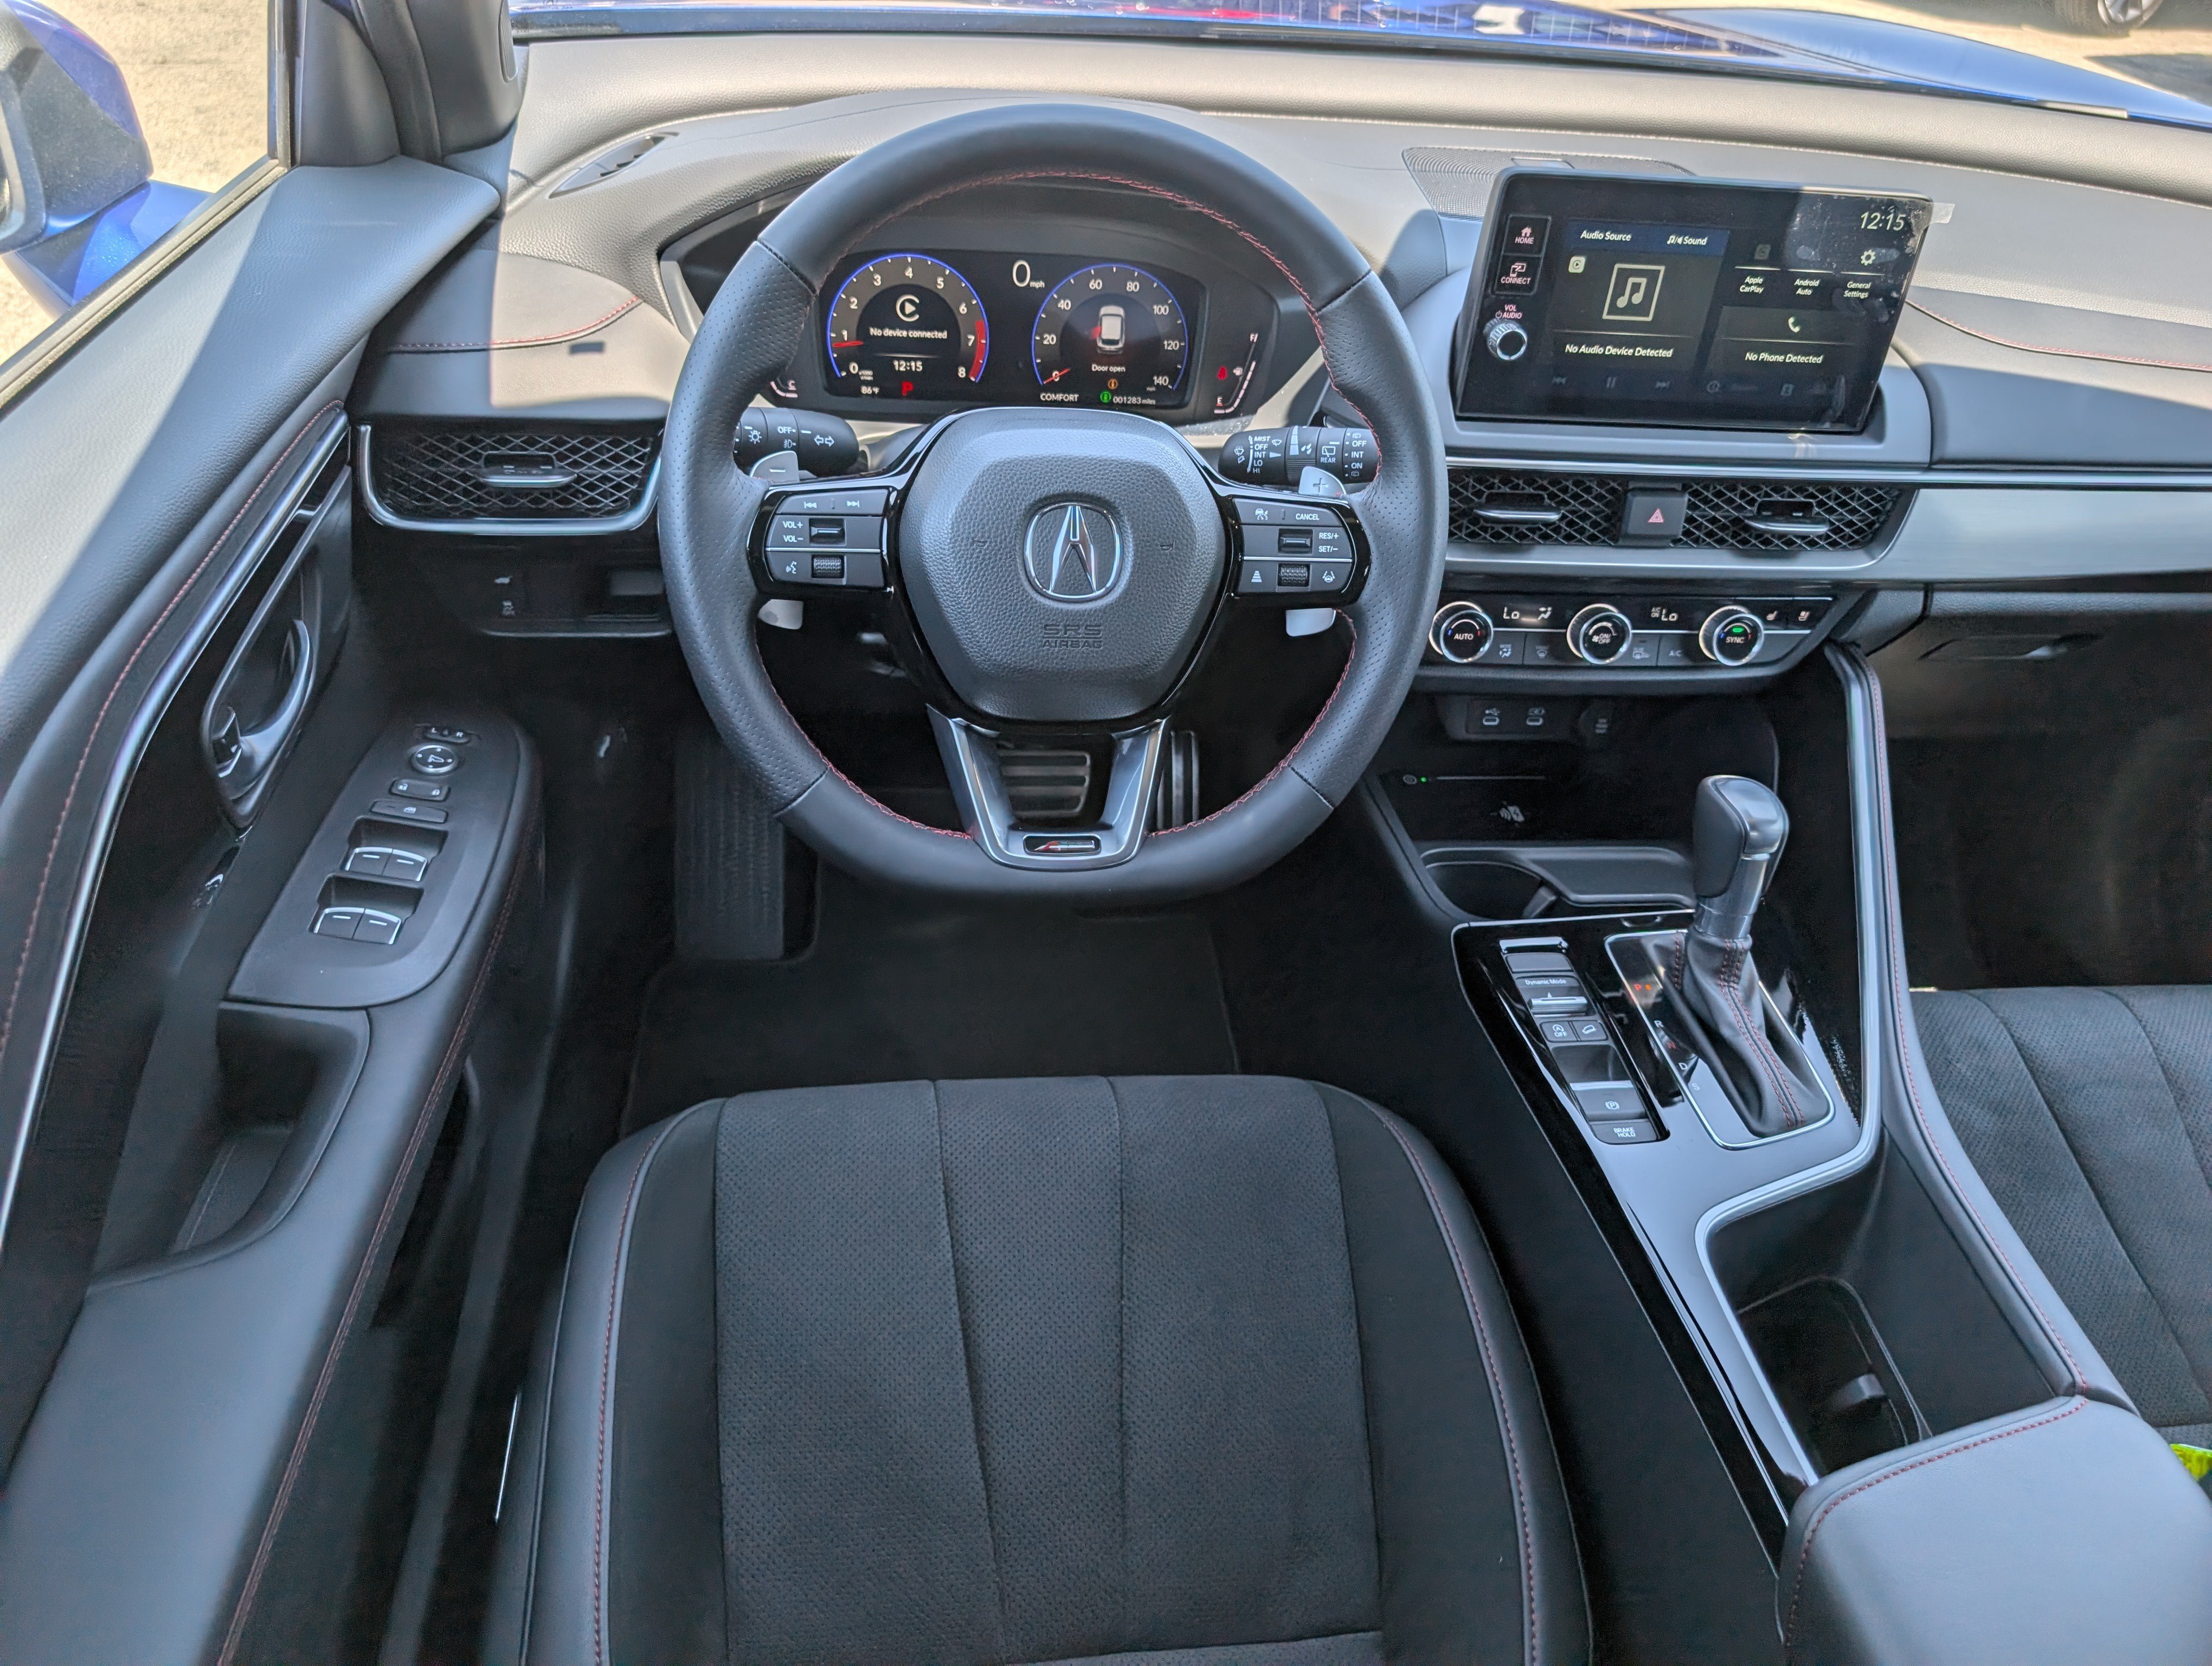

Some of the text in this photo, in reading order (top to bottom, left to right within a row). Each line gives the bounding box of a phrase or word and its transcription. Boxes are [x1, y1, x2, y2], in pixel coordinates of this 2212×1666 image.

[1860, 212, 1906, 230] 12:15
[1515, 236, 1534, 245] HOME
[1580, 230, 1632, 242] Audio Source
[1683, 236, 1707, 246] Sound
[904, 266, 913, 279] 4
[1012, 260, 1045, 290] 0 mph
[873, 273, 881, 286] 3
[936, 277, 944, 289] 5
[1089, 279, 1103, 290] 60
[1501, 276, 1531, 285] CONNECT
[1744, 275, 1764, 285] Apple
[1794, 278, 1820, 287] Android
[1126, 281, 1140, 292] 80
[1739, 285, 1764, 294] CarPlay
[1847, 281, 1871, 290] General
[1796, 287, 1812, 296] Auto
[1844, 290, 1869, 299] Settings
[849, 297, 858, 309] 2
[959, 302, 967, 315] 6
[1057, 299, 1071, 310] 40
[1153, 305, 1169, 316] 100
[841, 329, 847, 341] 1
[869, 327, 948, 339] No device connected
[967, 334, 975, 347] 7
[1043, 334, 1057, 345] 20
[1163, 340, 1180, 350] 120
[1565, 343, 1673, 358] No Audio Device Detected
[1745, 351, 1824, 364] No Phone Detected
[848, 362, 858, 374] 0
[893, 360, 923, 372] 12:15
[1091, 363, 1108, 372] Door
[957, 366, 966, 378] 8
[1153, 375, 1169, 386] 140
[901, 381, 914, 396] P
[1039, 393, 1079, 402] COMFORT
[1113, 396, 1142, 405] 001283
[777, 426, 792, 434] OFF
[782, 521, 803, 529] VOL+
[1043, 624, 1103, 637] SRS
[1041, 639, 1103, 650] AIRBAG
[1725, 636, 1746, 644] SYNC
[1678, 1062, 1688, 1070] D
[1691, 1082, 1700, 1091] S
